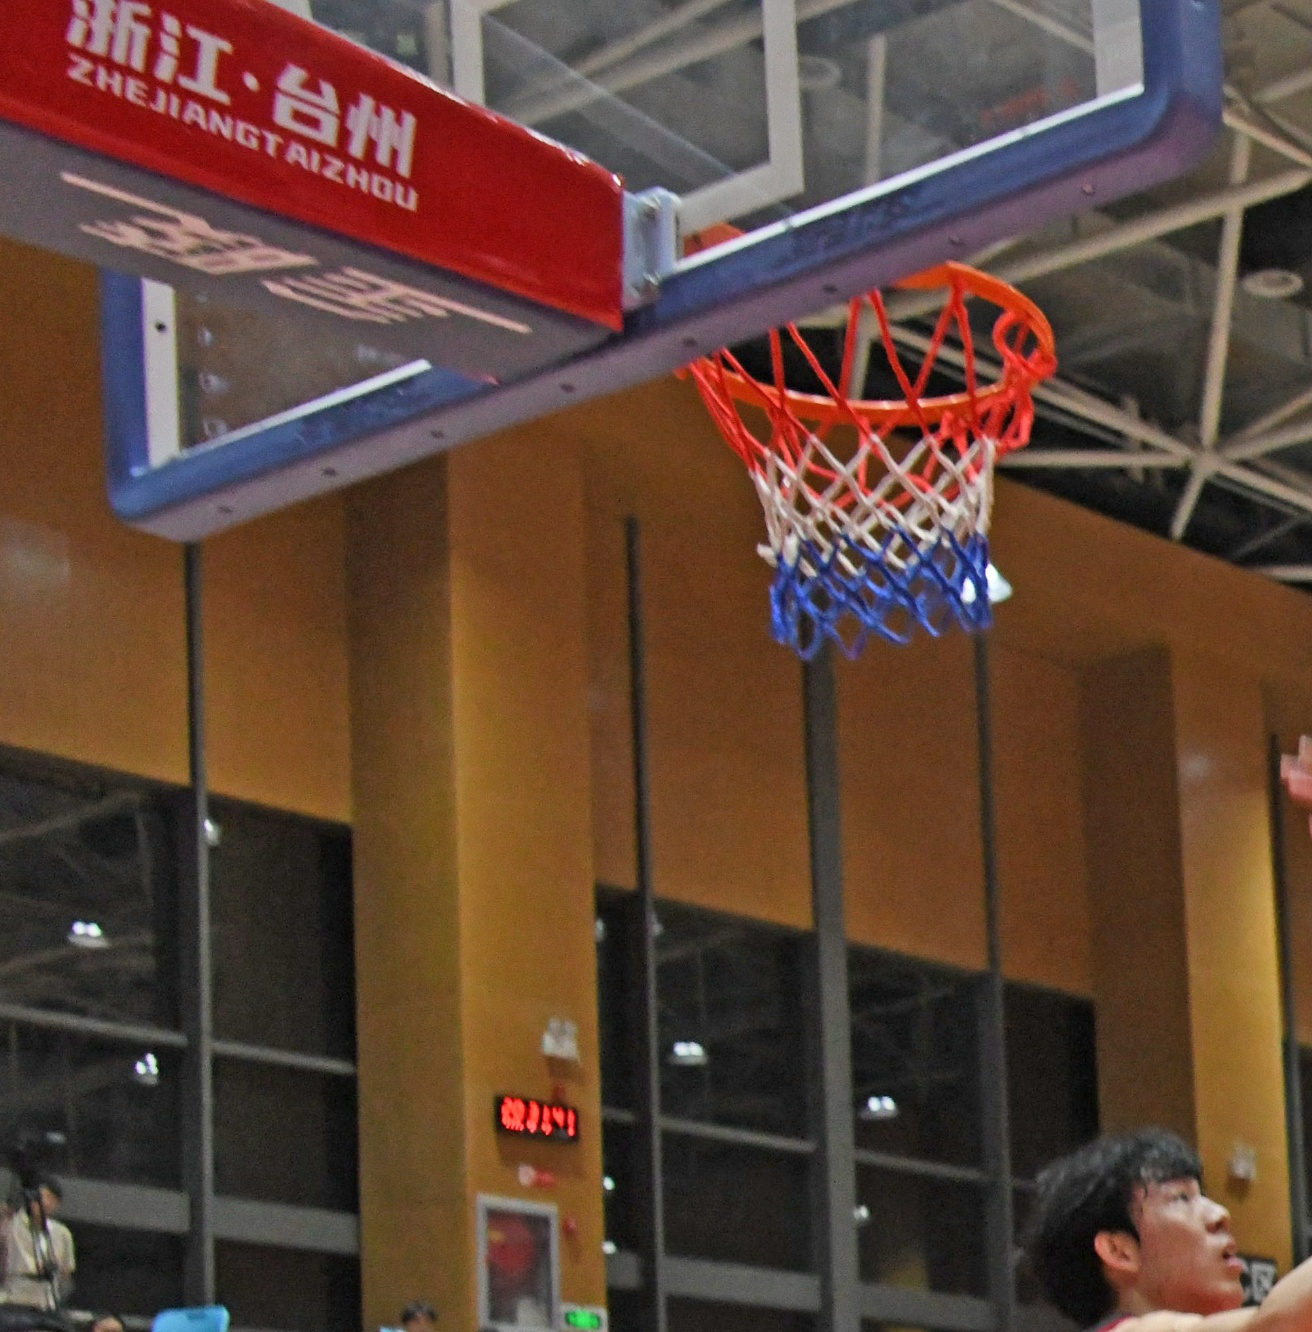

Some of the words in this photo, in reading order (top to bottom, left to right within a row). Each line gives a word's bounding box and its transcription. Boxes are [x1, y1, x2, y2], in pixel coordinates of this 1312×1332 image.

[66, 0, 417, 179] 浙江·台州
[67, 52, 418, 212] ZHEJIANGTAIZHOU
